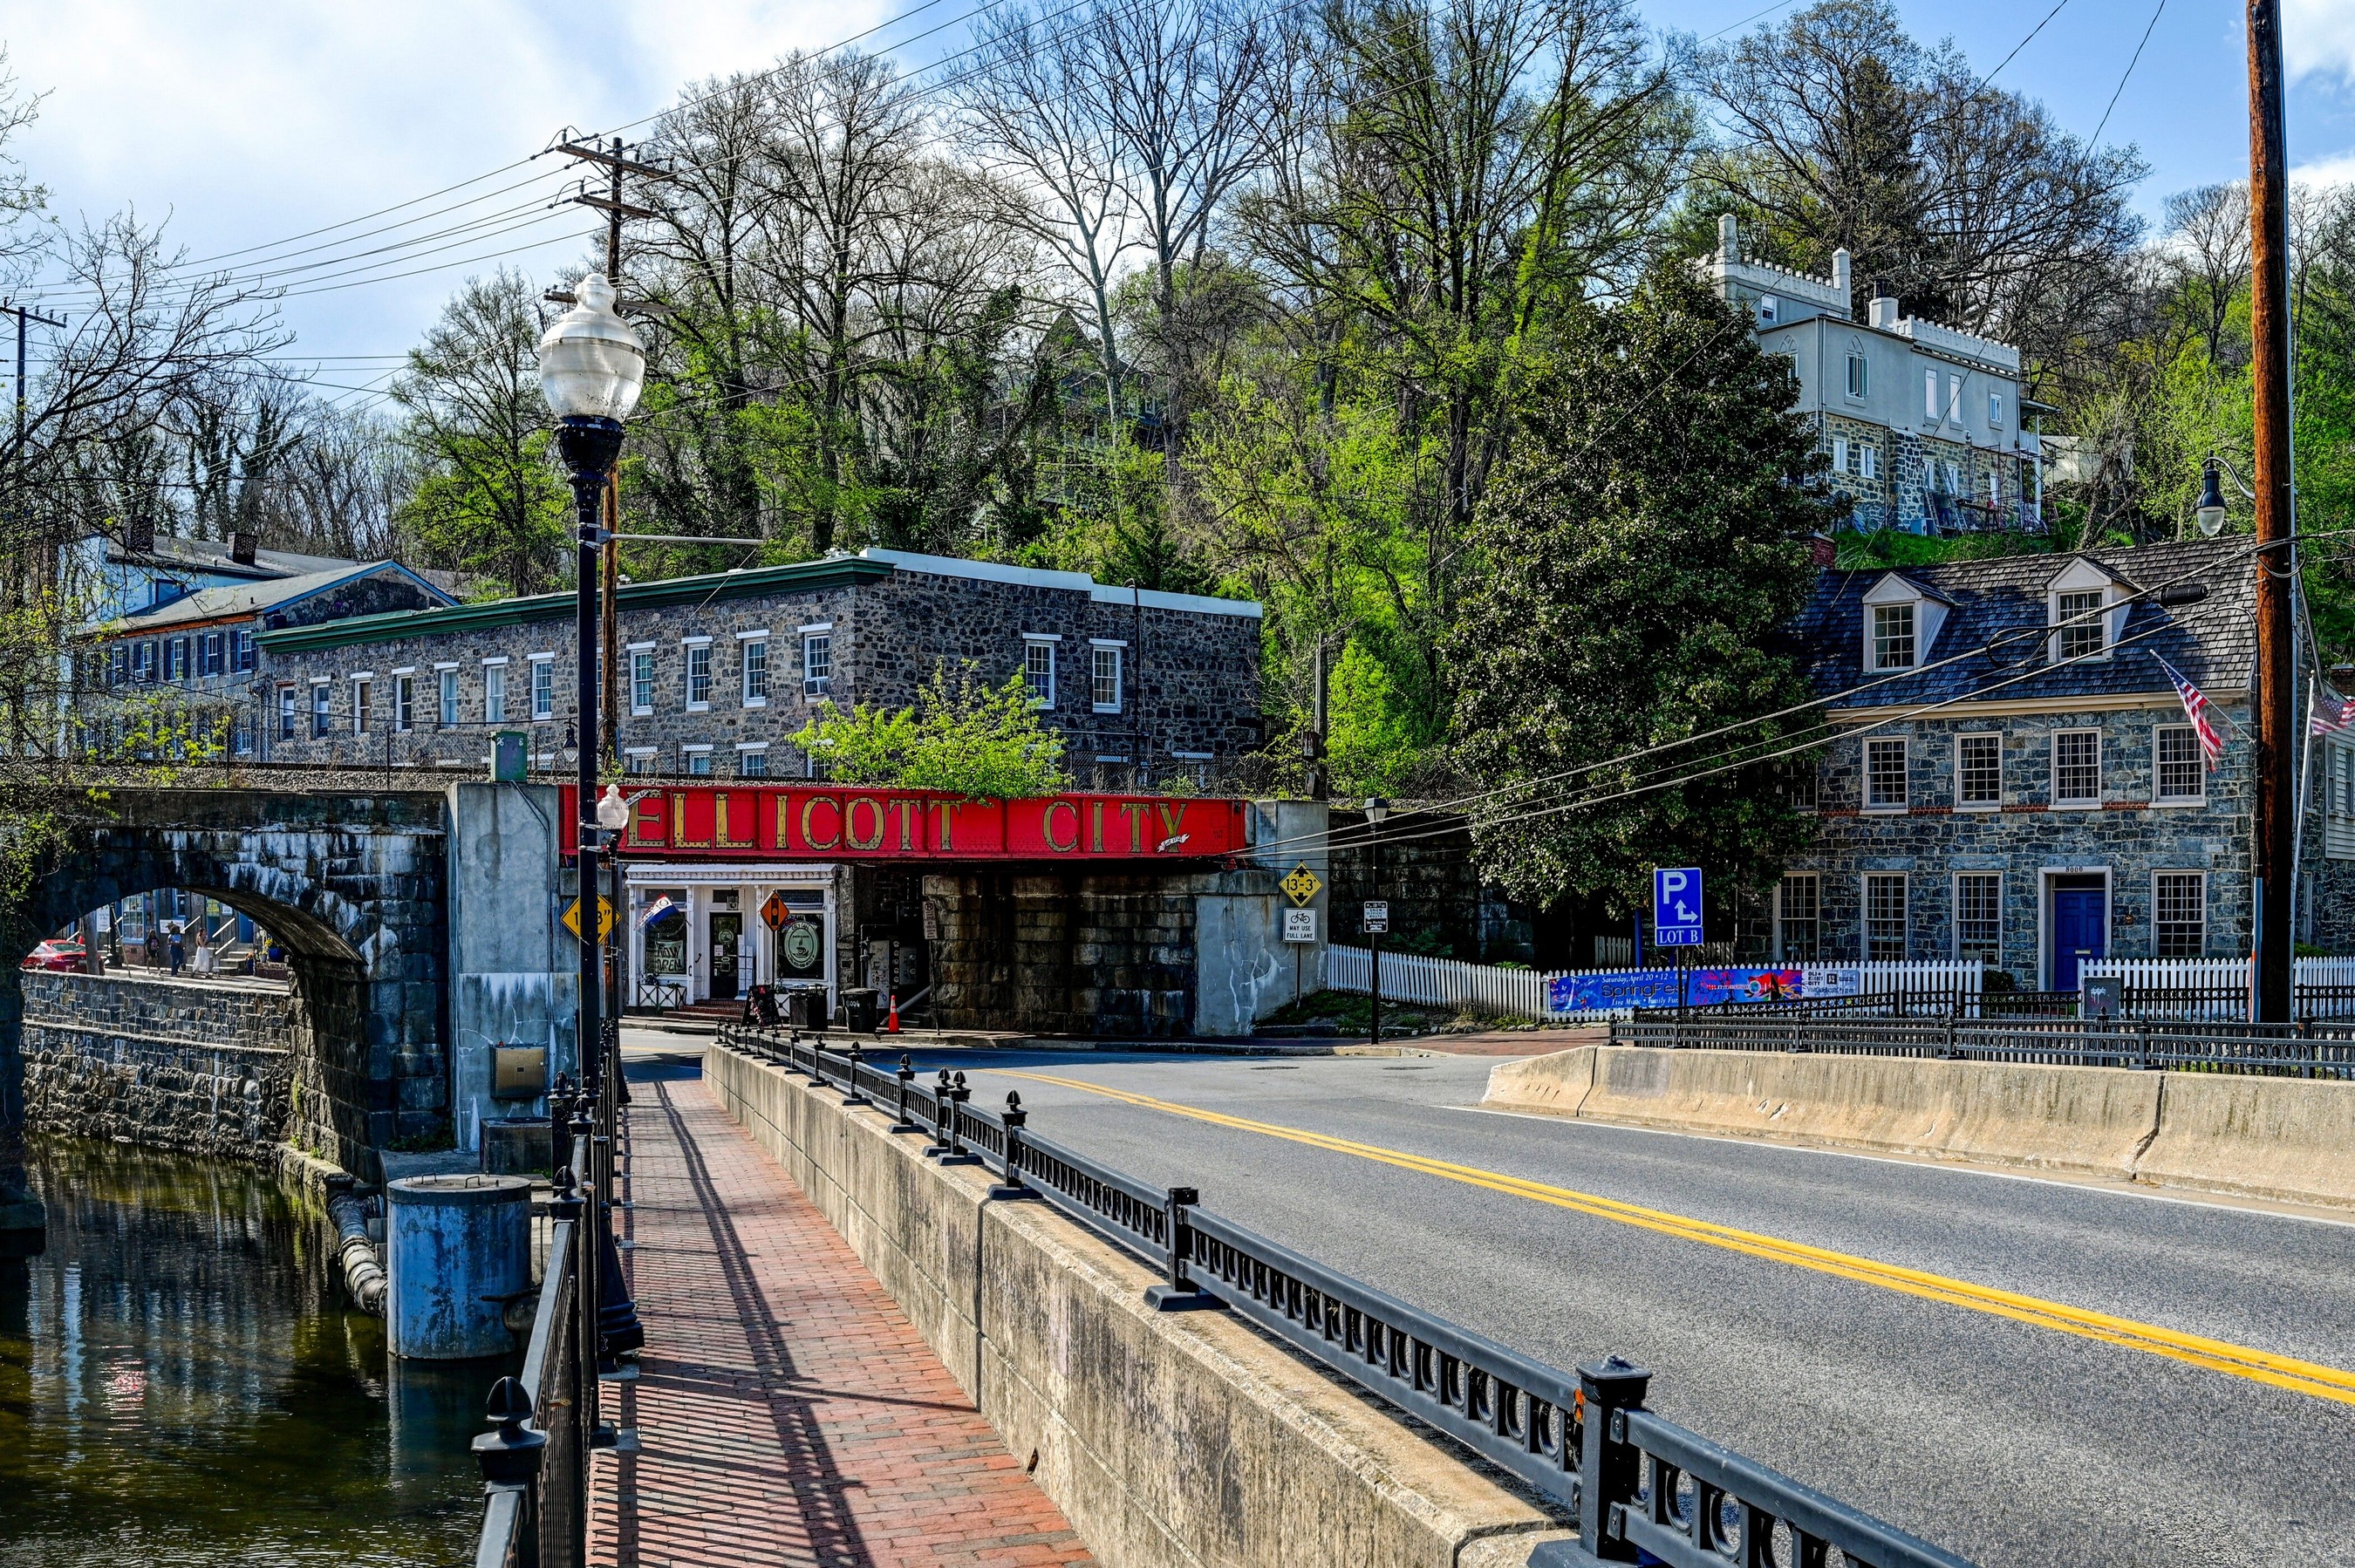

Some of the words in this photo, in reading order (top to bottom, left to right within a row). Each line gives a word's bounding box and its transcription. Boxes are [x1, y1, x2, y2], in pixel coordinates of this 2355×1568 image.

[626, 789, 961, 851] ELLICOTT
[1042, 801, 1188, 854] CITY
[1286, 878, 1317, 891] 13'-3"
[1662, 871, 1688, 904] P
[1659, 930, 1684, 944] LOT
[1690, 930, 1698, 943] B
[1601, 975, 1628, 985] Saturday,
[1629, 973, 1644, 984] April
[1674, 971, 1688, 980] 8m
[1601, 982, 1685, 999] SpringFes
